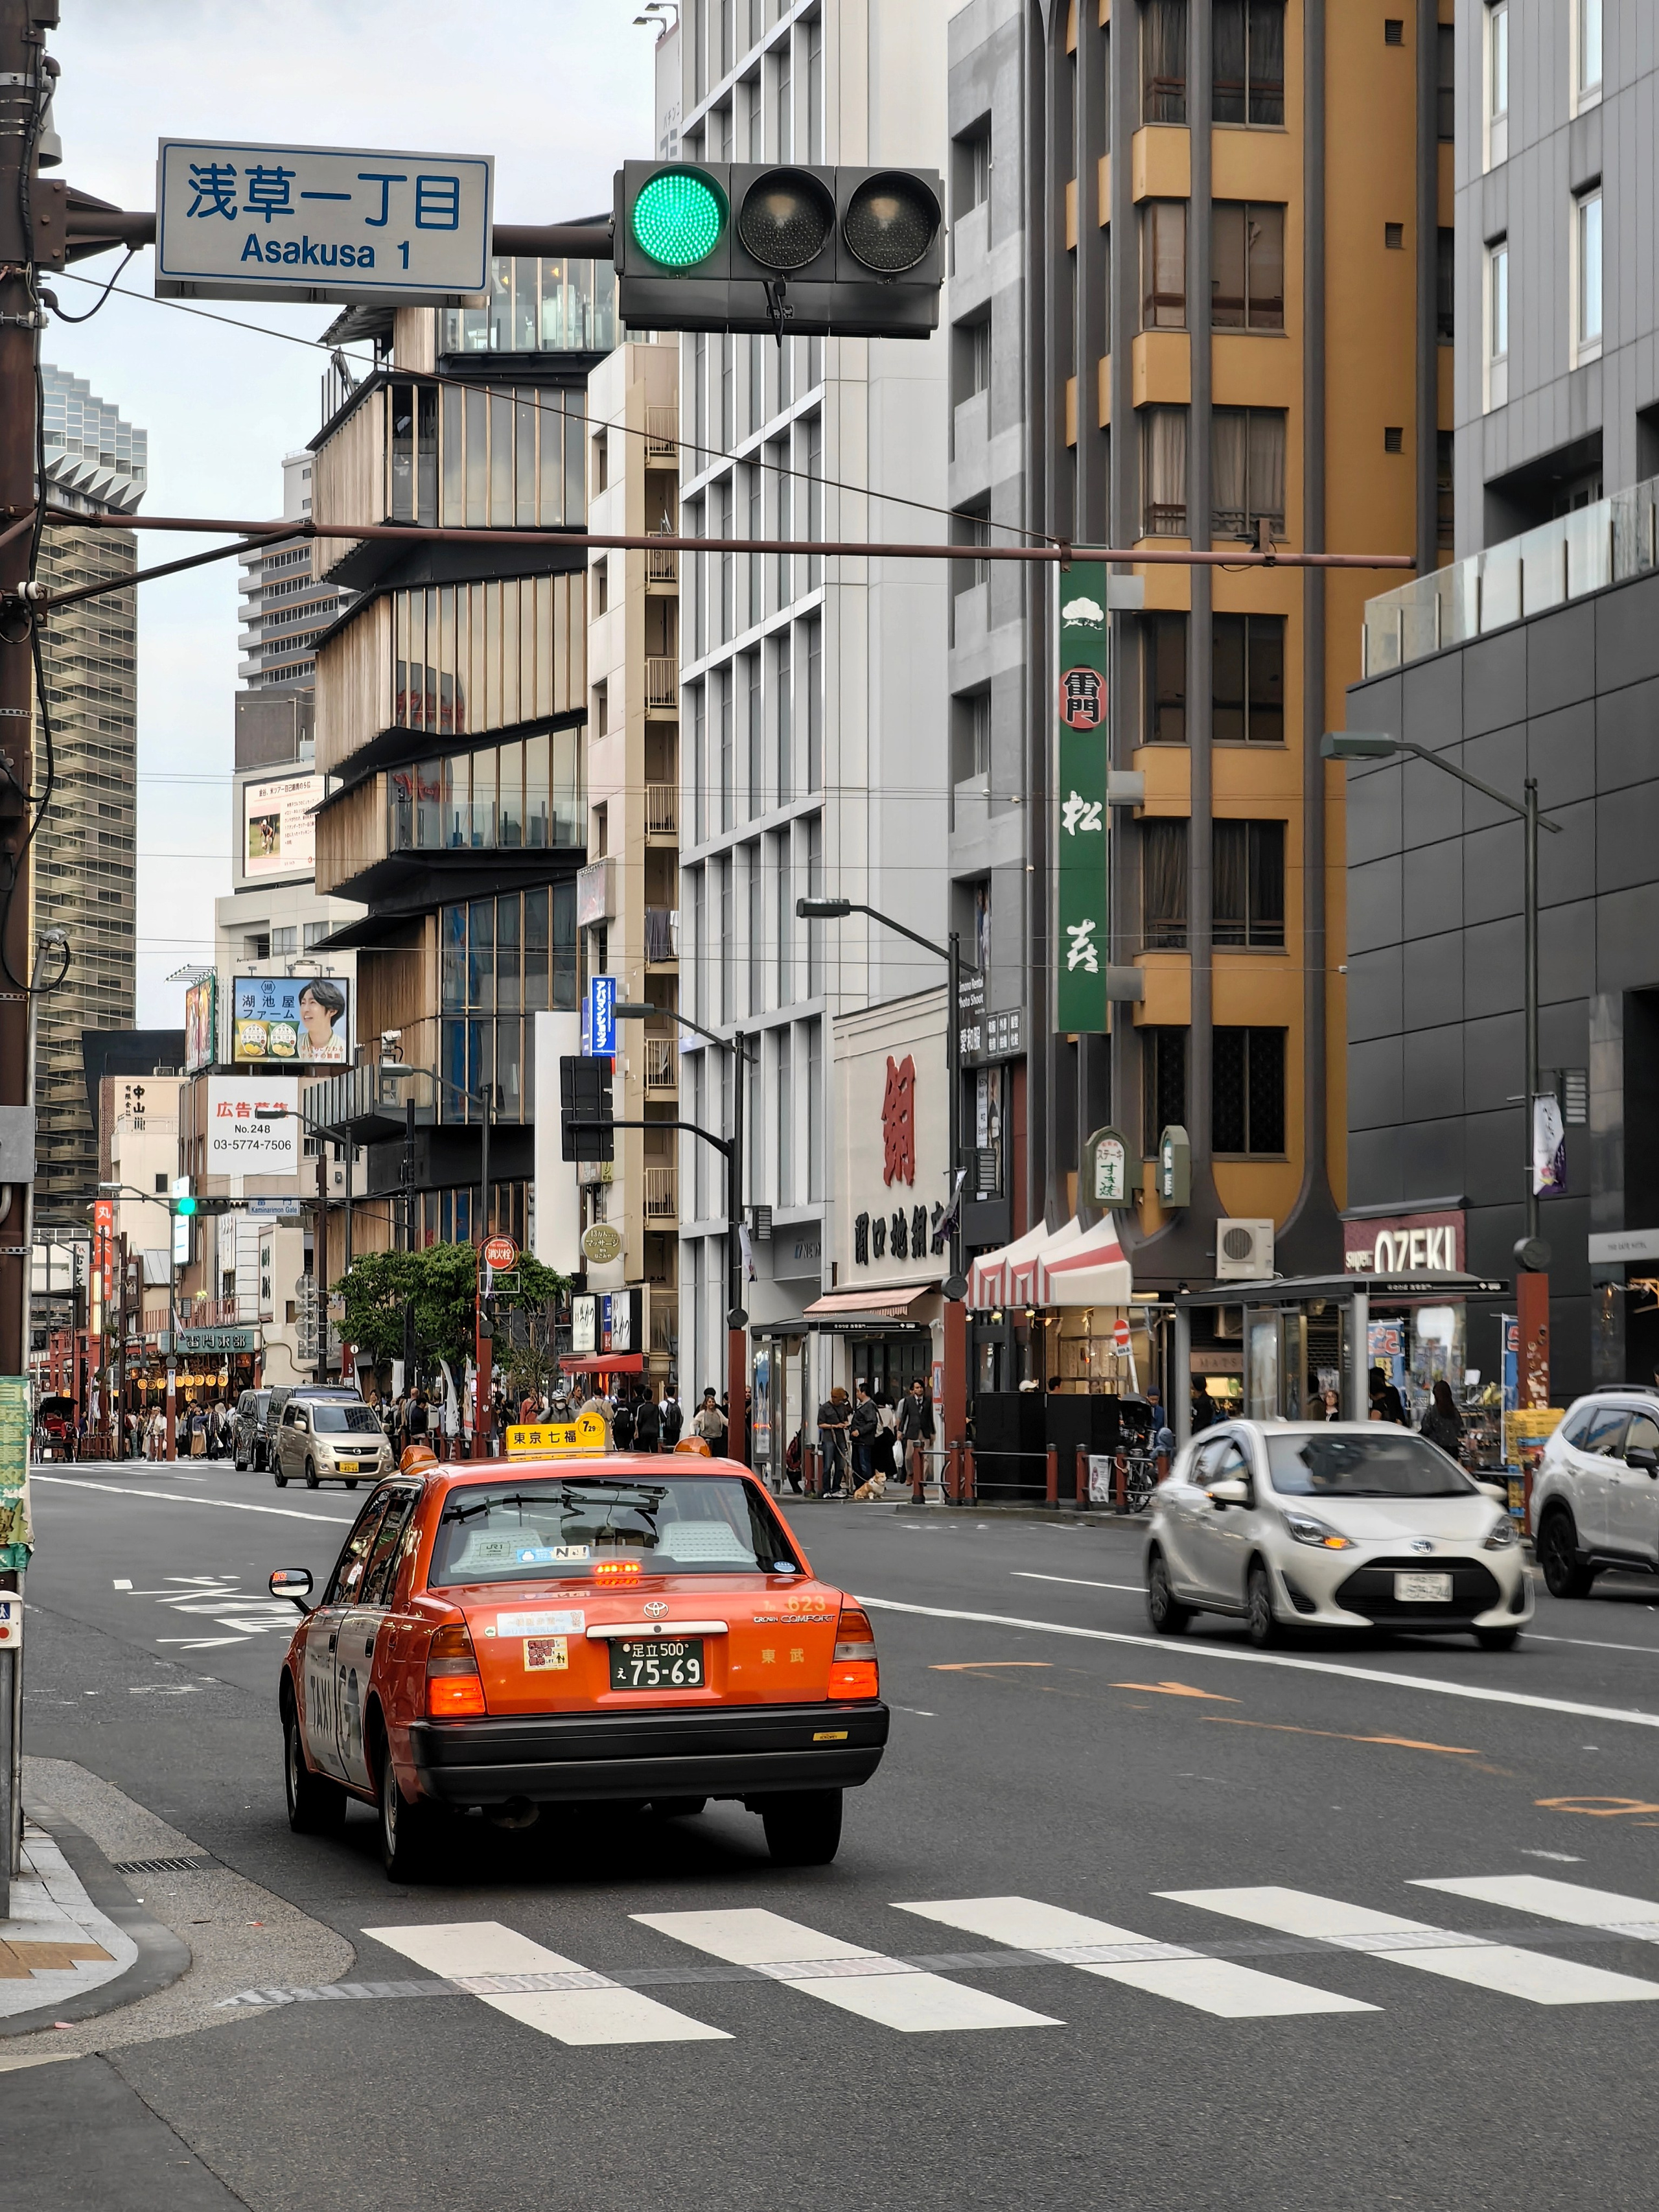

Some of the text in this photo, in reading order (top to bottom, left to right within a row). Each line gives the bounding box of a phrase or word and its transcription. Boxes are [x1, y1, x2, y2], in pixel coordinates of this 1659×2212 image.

[187, 162, 461, 231] 浅草一丁目
[240, 233, 411, 270] Asakusa 1
[1065, 670, 1100, 723] 雷門
[242, 995, 296, 1008] 湖池屋
[243, 1008, 296, 1020] ファーム
[596, 981, 607, 1048] アパマンショップ
[960, 1026, 981, 1053] 愛和服
[235, 1124, 271, 1134] No.248
[213, 1139, 292, 1150] 03-5774-7506
[586, 1239, 620, 1248] マッサージ
[487, 1248, 511, 1260] 消火栓
[513, 1430, 577, 1445] 東京七福
[788, 1595, 826, 1612] 623
[780, 1614, 836, 1624] COMFORT
[761, 1648, 804, 1664] 東武
[616, 1668, 627, 1680] え
[630, 1658, 701, 1686] 75-69
